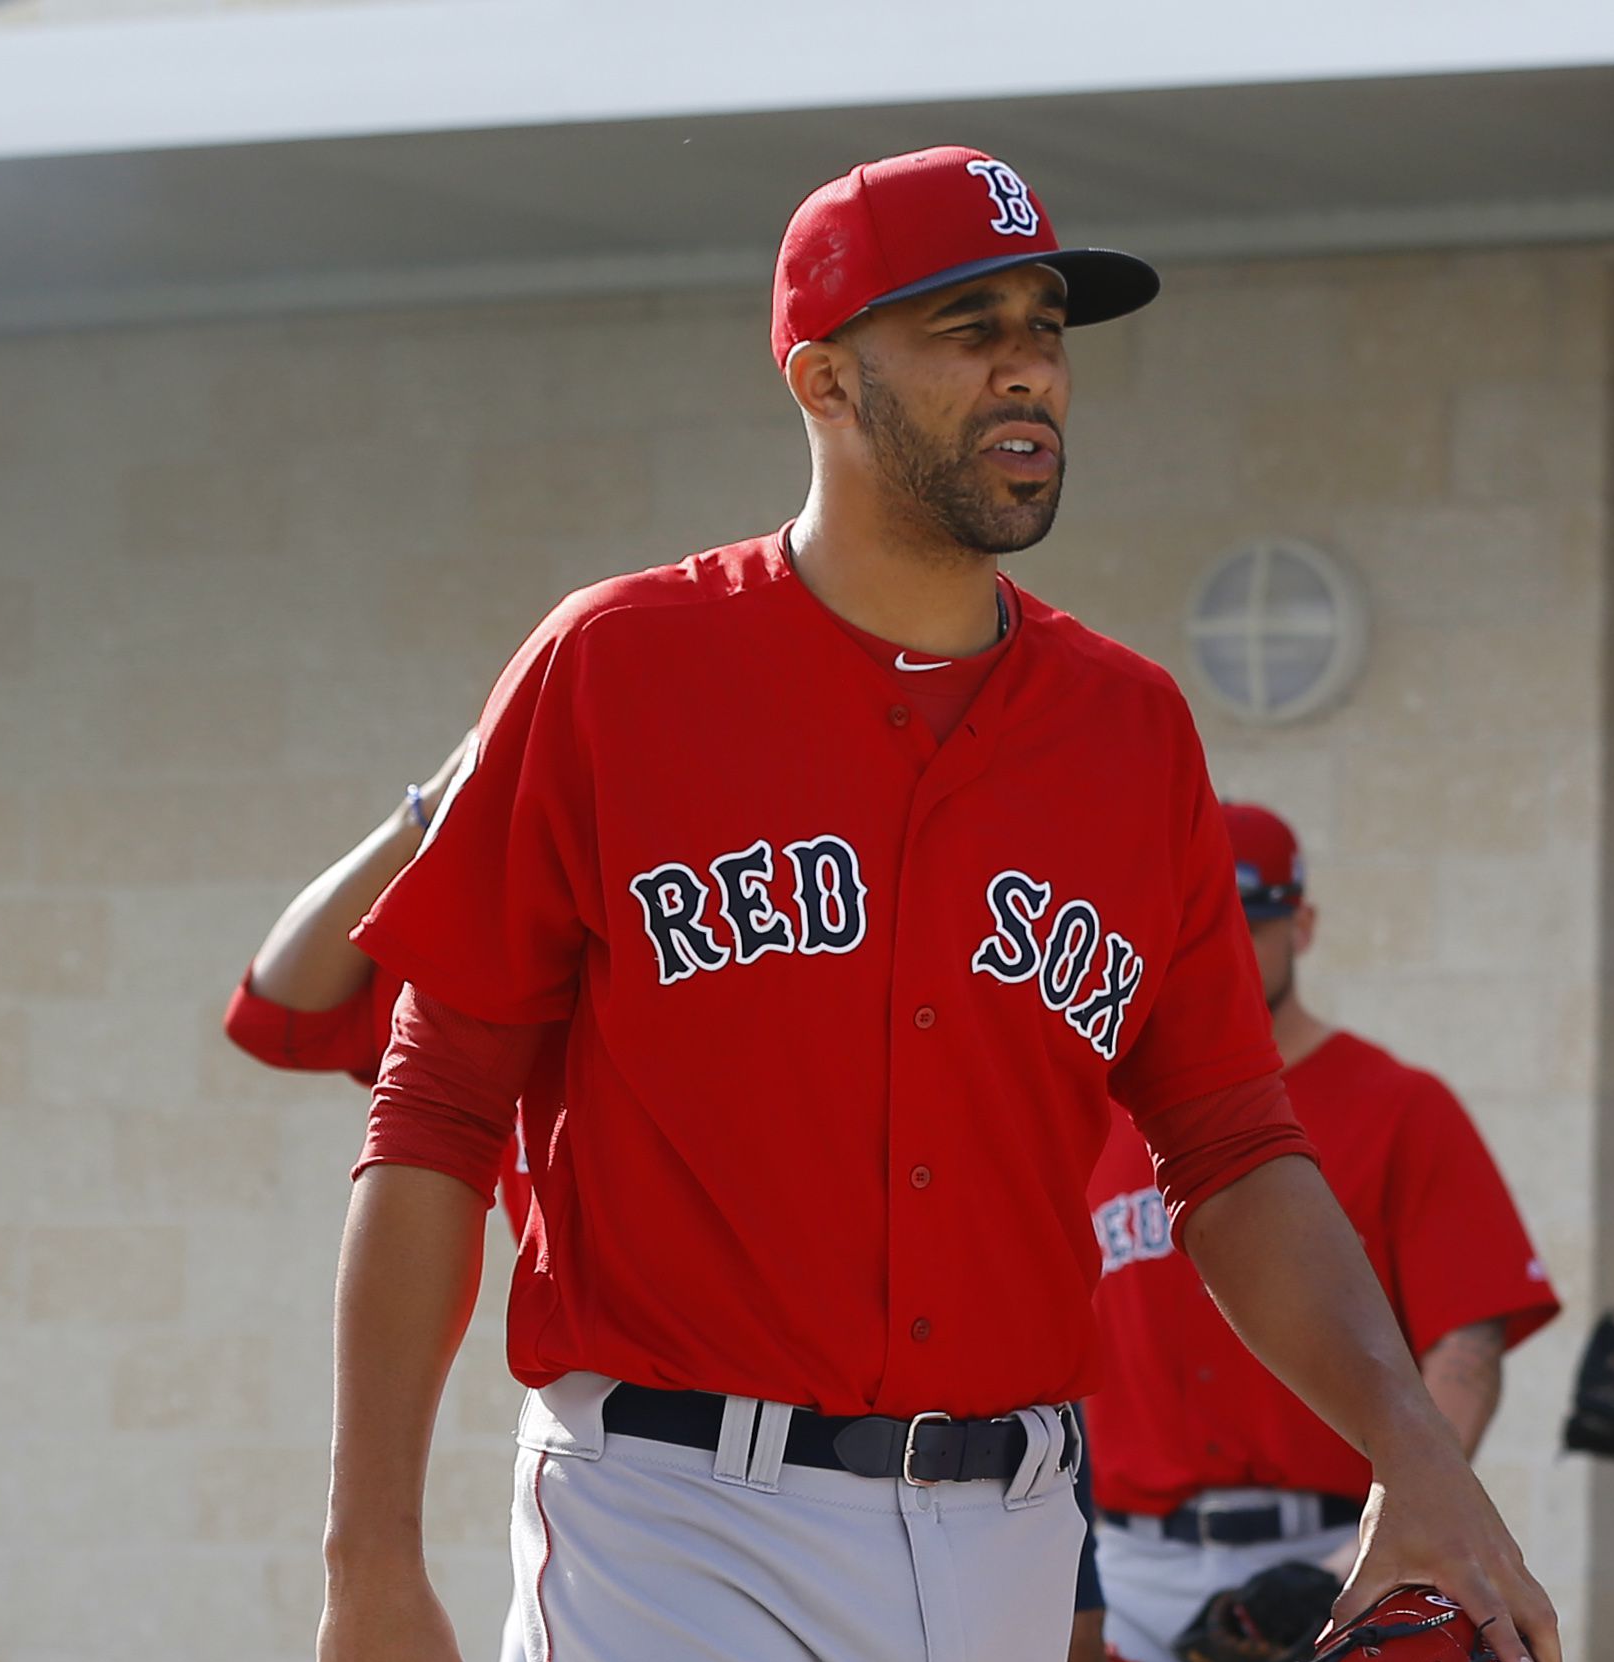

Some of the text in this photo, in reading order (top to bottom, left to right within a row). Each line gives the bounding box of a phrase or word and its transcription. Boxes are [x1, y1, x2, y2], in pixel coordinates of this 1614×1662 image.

[967, 160, 1039, 237] B
[629, 834, 1145, 1060] RED SOX
[1092, 1185, 1175, 1278] ED
